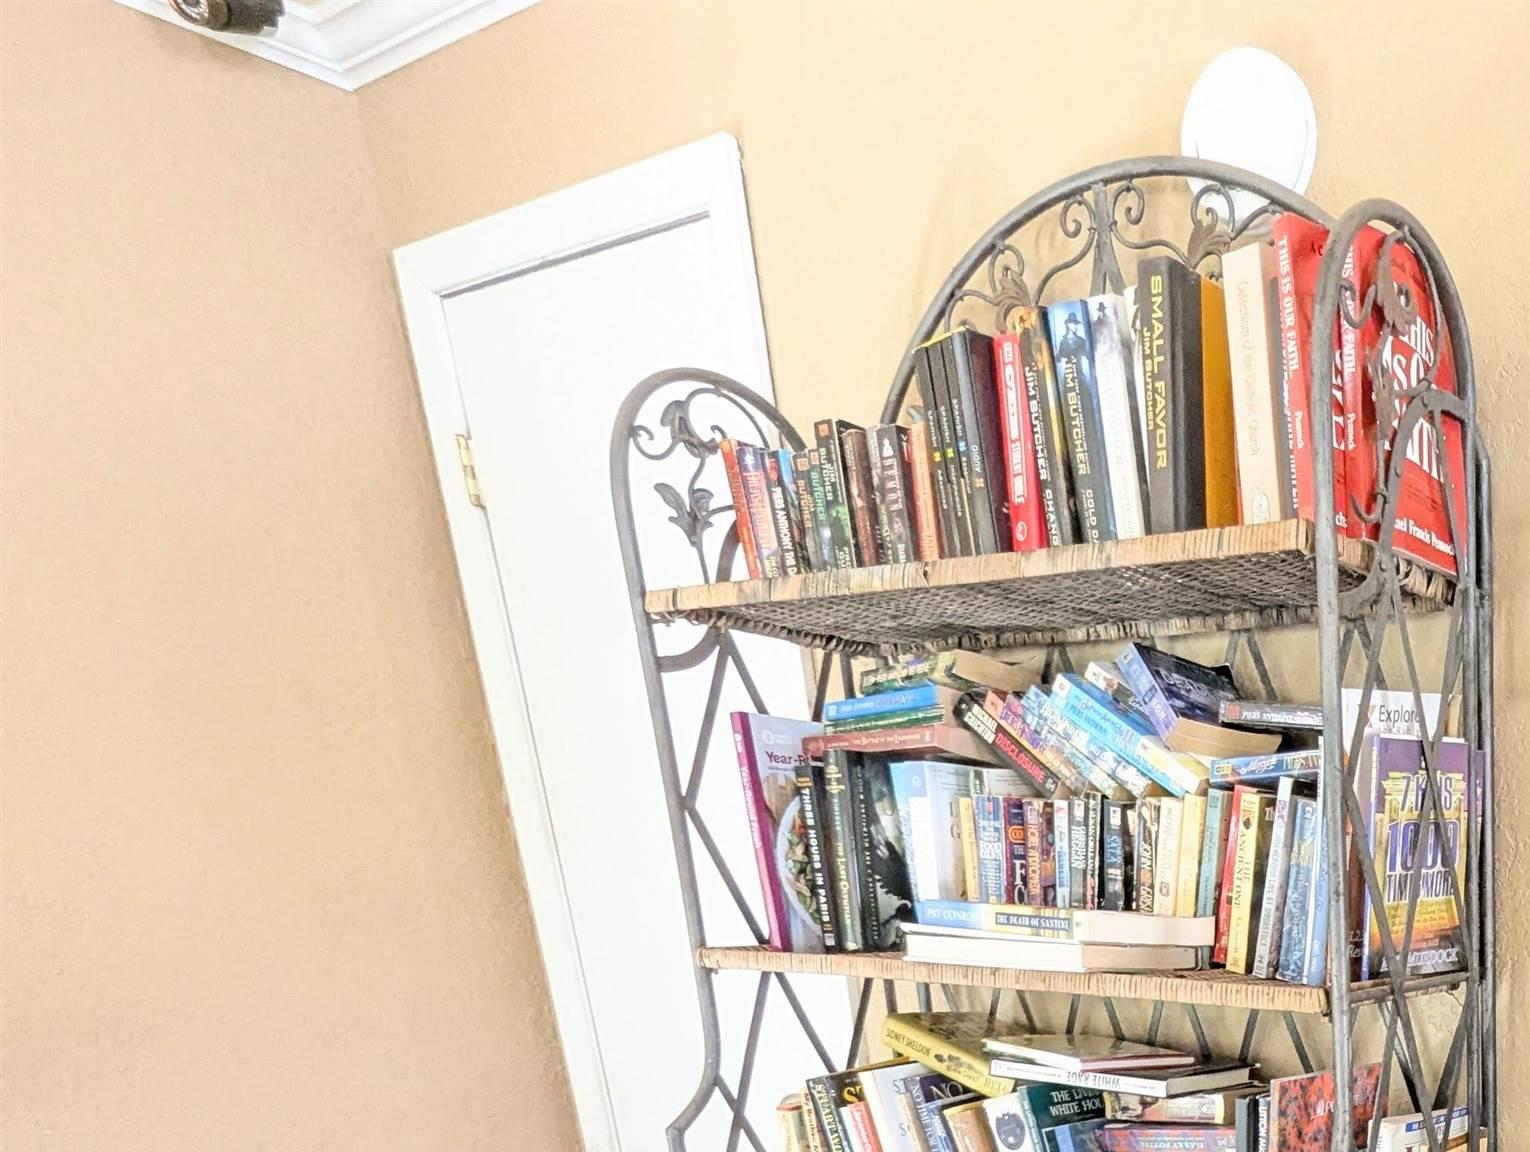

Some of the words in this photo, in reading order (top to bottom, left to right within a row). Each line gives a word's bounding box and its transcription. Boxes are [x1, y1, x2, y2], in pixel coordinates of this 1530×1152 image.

[1275, 235, 1291, 275] THIS
[1280, 277, 1292, 293] IS
[1147, 274, 1167, 373] SMALL
[1281, 295, 1295, 327] OUR
[1141, 326, 1151, 353] JIM
[1024, 365, 1036, 394] JIM
[1063, 359, 1075, 388] JIM
[1143, 359, 1155, 431] BUTCHER
[927, 409, 938, 447] SPANISH
[939, 406, 951, 442] SPANISH
[952, 398, 963, 436] SPANISH
[1068, 391, 1086, 476] BUTCHER
[1150, 379, 1170, 469] FAVOR
[1293, 411, 1306, 449] Pennock
[1346, 413, 1357, 450] Pennock
[1029, 399, 1047, 481] BUTCHER
[818, 447, 833, 501] BUTCHER
[1085, 488, 1096, 522] COLD
[774, 509, 794, 551] ANTHONY
[991, 732, 1050, 784] DISCLOSURE
[800, 788, 815, 825] THREE
[806, 828, 823, 869] HOURS
[814, 871, 824, 885] IN
[837, 857, 848, 880] LAST
[816, 887, 831, 922] PARIS
[1009, 915, 1030, 926] DEATH
[1031, 916, 1039, 926] OF
[1040, 917, 1069, 929] SANTINI
[801, 1092, 810, 1105] My
[814, 1082, 837, 1132] STUART
[909, 1084, 923, 1101] NO
[1050, 1102, 1079, 1117] WHITE
[1052, 1090, 1071, 1102] THE
[915, 1102, 931, 1125] TIME
[924, 1125, 938, 1146] FOR
